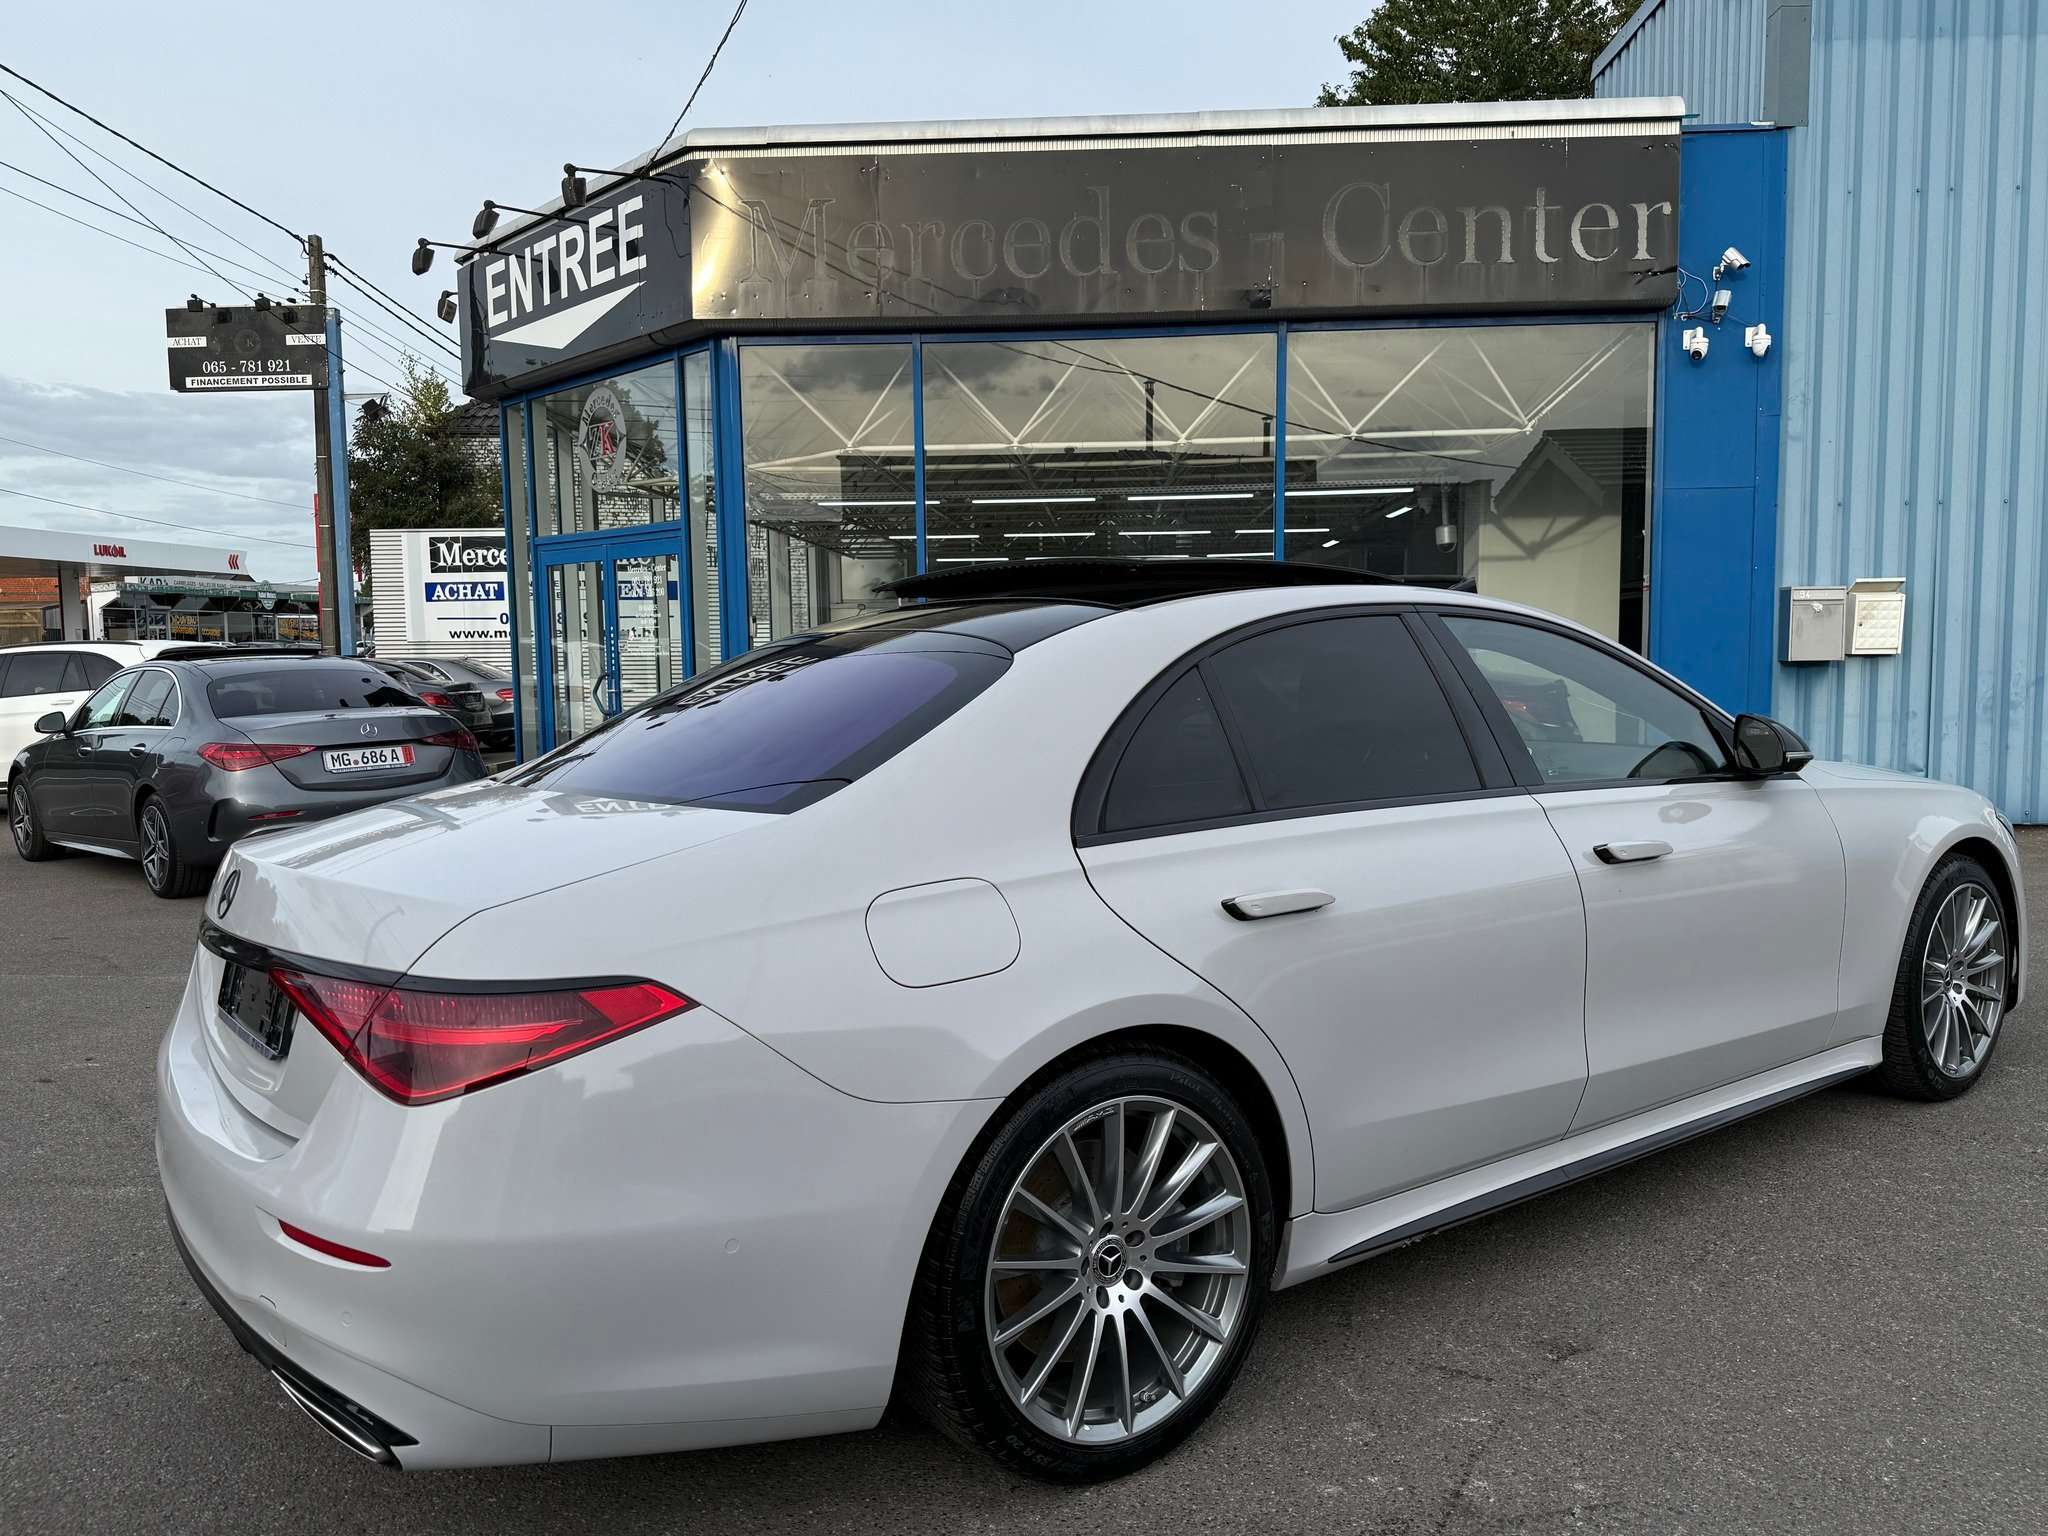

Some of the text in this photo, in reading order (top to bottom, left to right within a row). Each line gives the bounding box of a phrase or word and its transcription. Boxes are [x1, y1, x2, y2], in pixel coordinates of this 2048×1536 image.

[738, 186, 1220, 284] Mercedes
[1323, 181, 1673, 268] Center
[485, 195, 647, 328] ENTREE
[172, 337, 202, 347] ACHAT
[291, 334, 322, 344] VENTE
[202, 360, 227, 373] 065
[239, 360, 263, 373] 781
[267, 360, 291, 372] 921
[191, 376, 308, 386] FINANCEMENT POSSIBLE
[93, 543, 127, 558] LUKOIL
[432, 584, 498, 600] ACHAT
[449, 630, 512, 639] www.m
[331, 753, 351, 768] MG
[361, 750, 388, 764] 686
[391, 749, 400, 763] A
